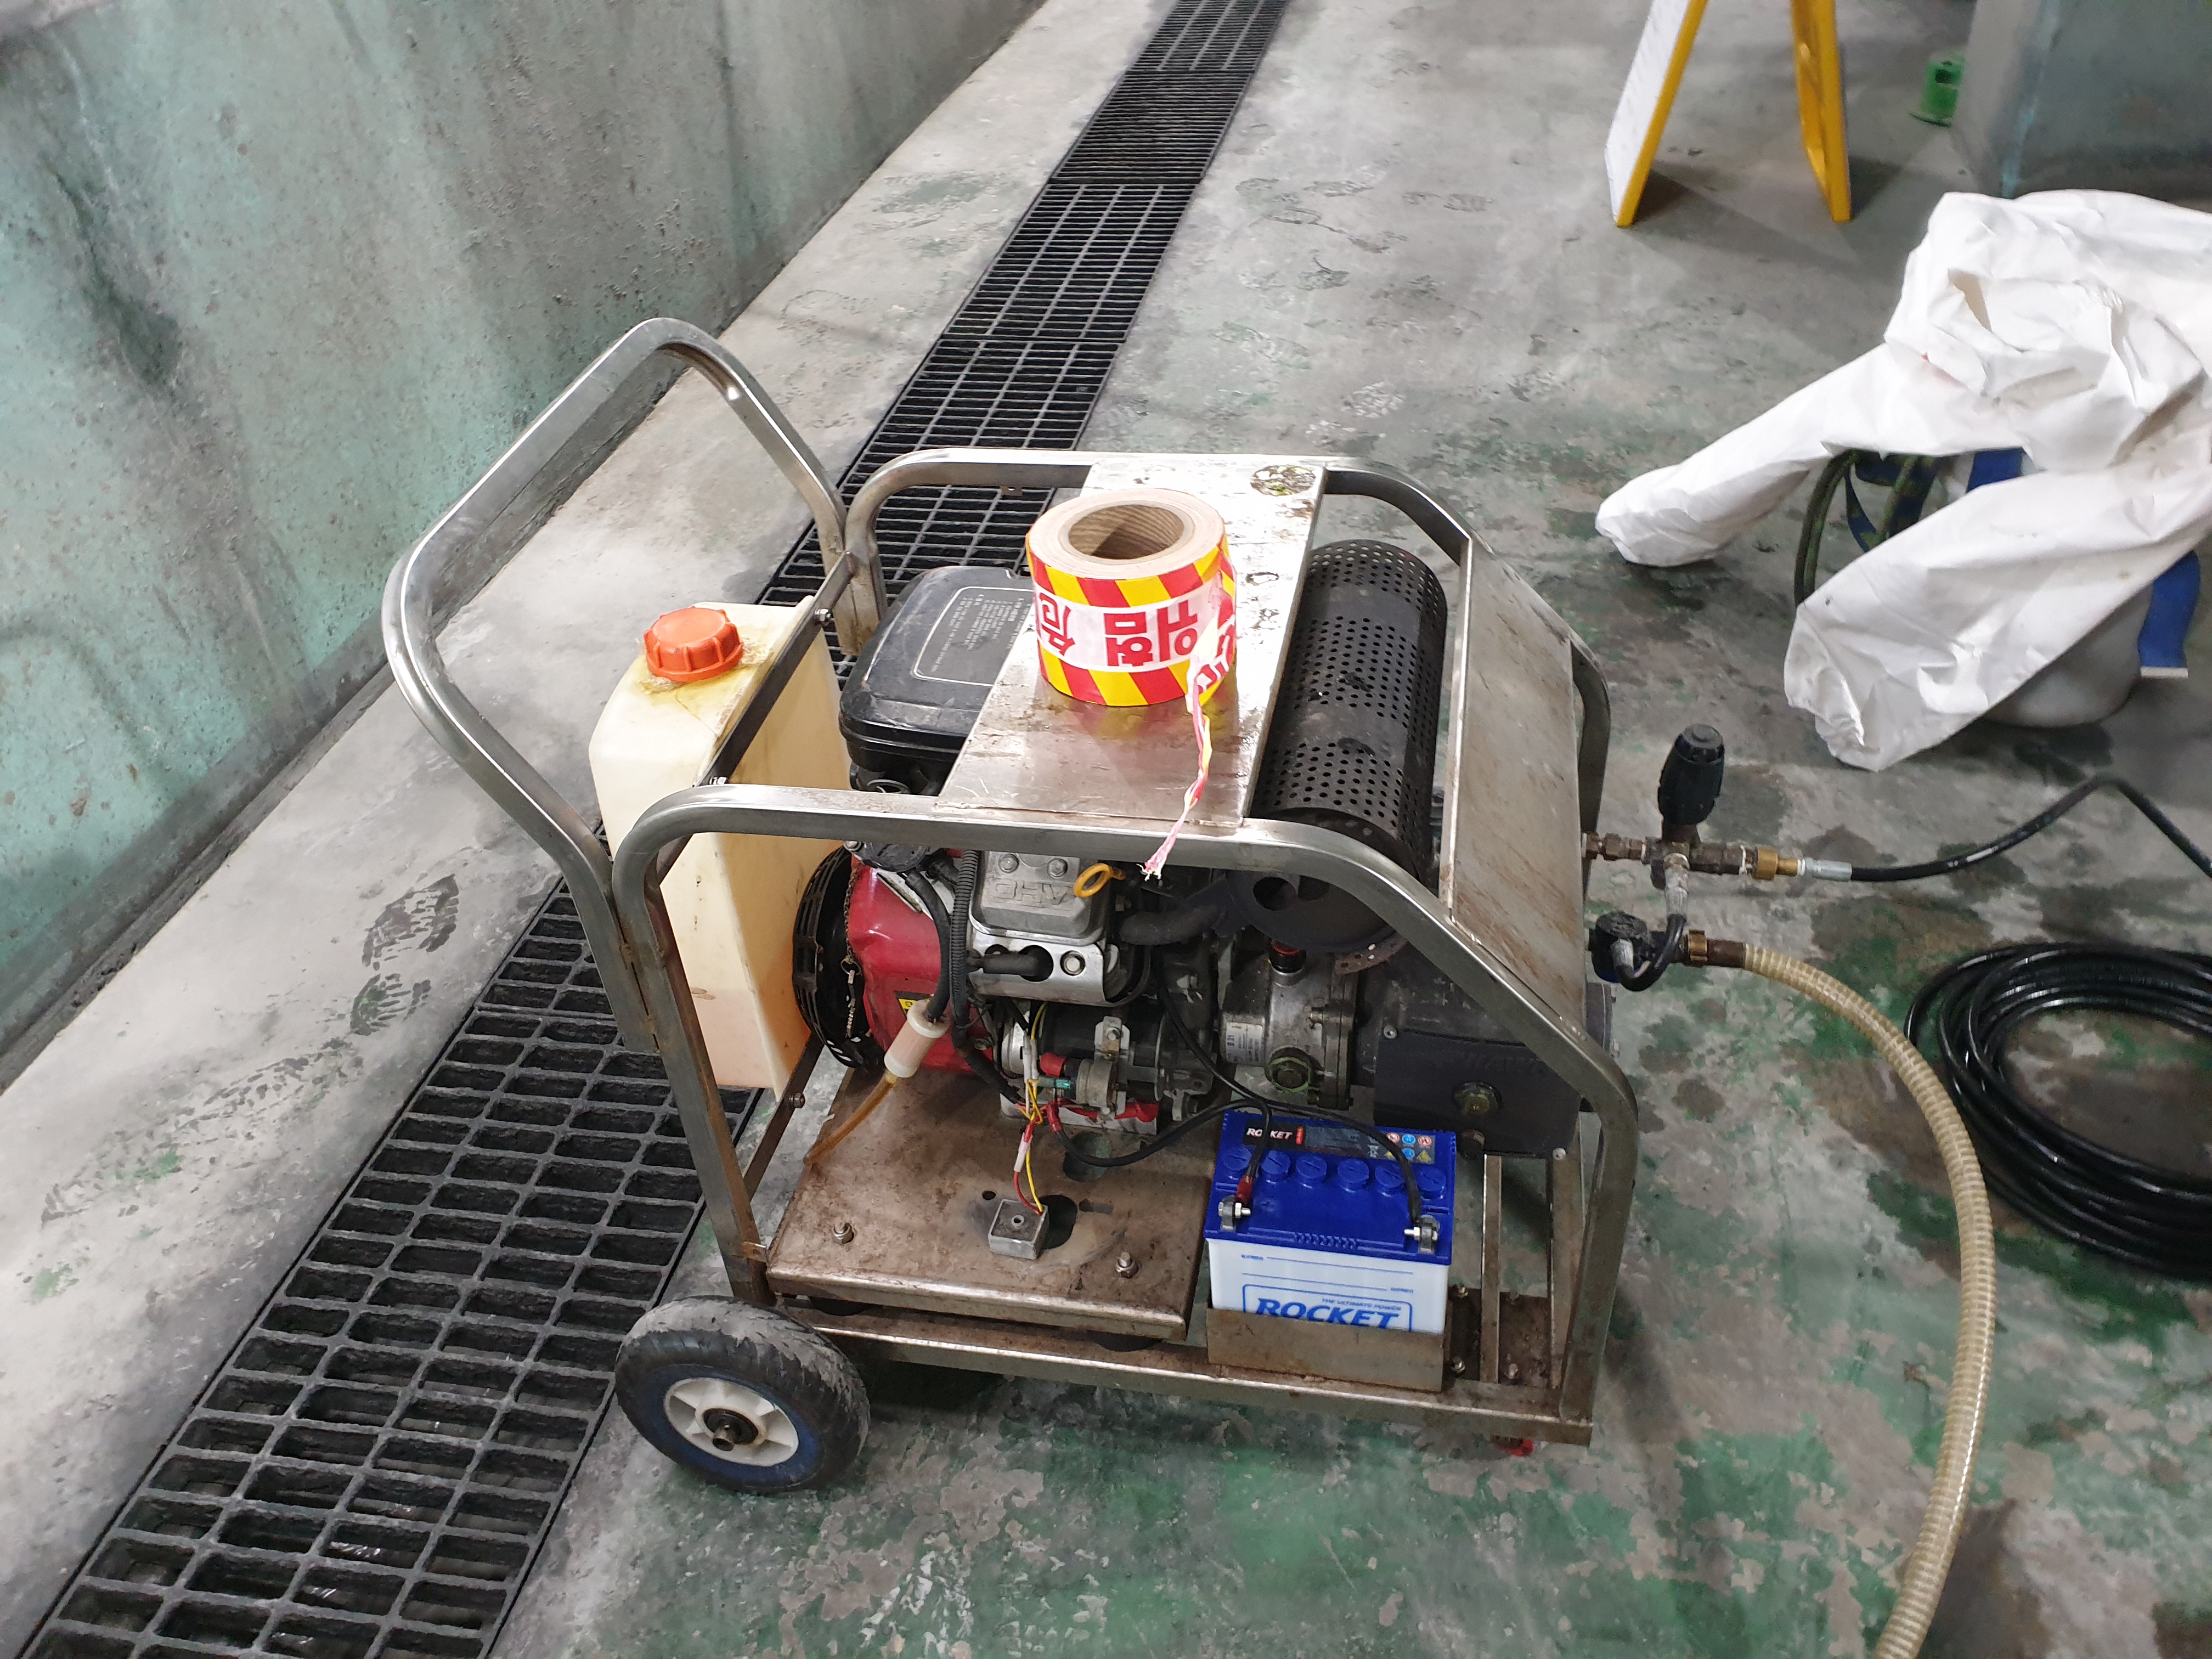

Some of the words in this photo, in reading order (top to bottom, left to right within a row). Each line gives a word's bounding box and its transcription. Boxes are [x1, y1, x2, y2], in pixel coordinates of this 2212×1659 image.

[1036, 592, 1076, 657] 危
[1104, 600, 1198, 667] 위험
[990, 880, 1072, 905] OHV
[1246, 1128, 1293, 1140] ROKET
[1255, 1298, 1399, 1329] ROCKET
